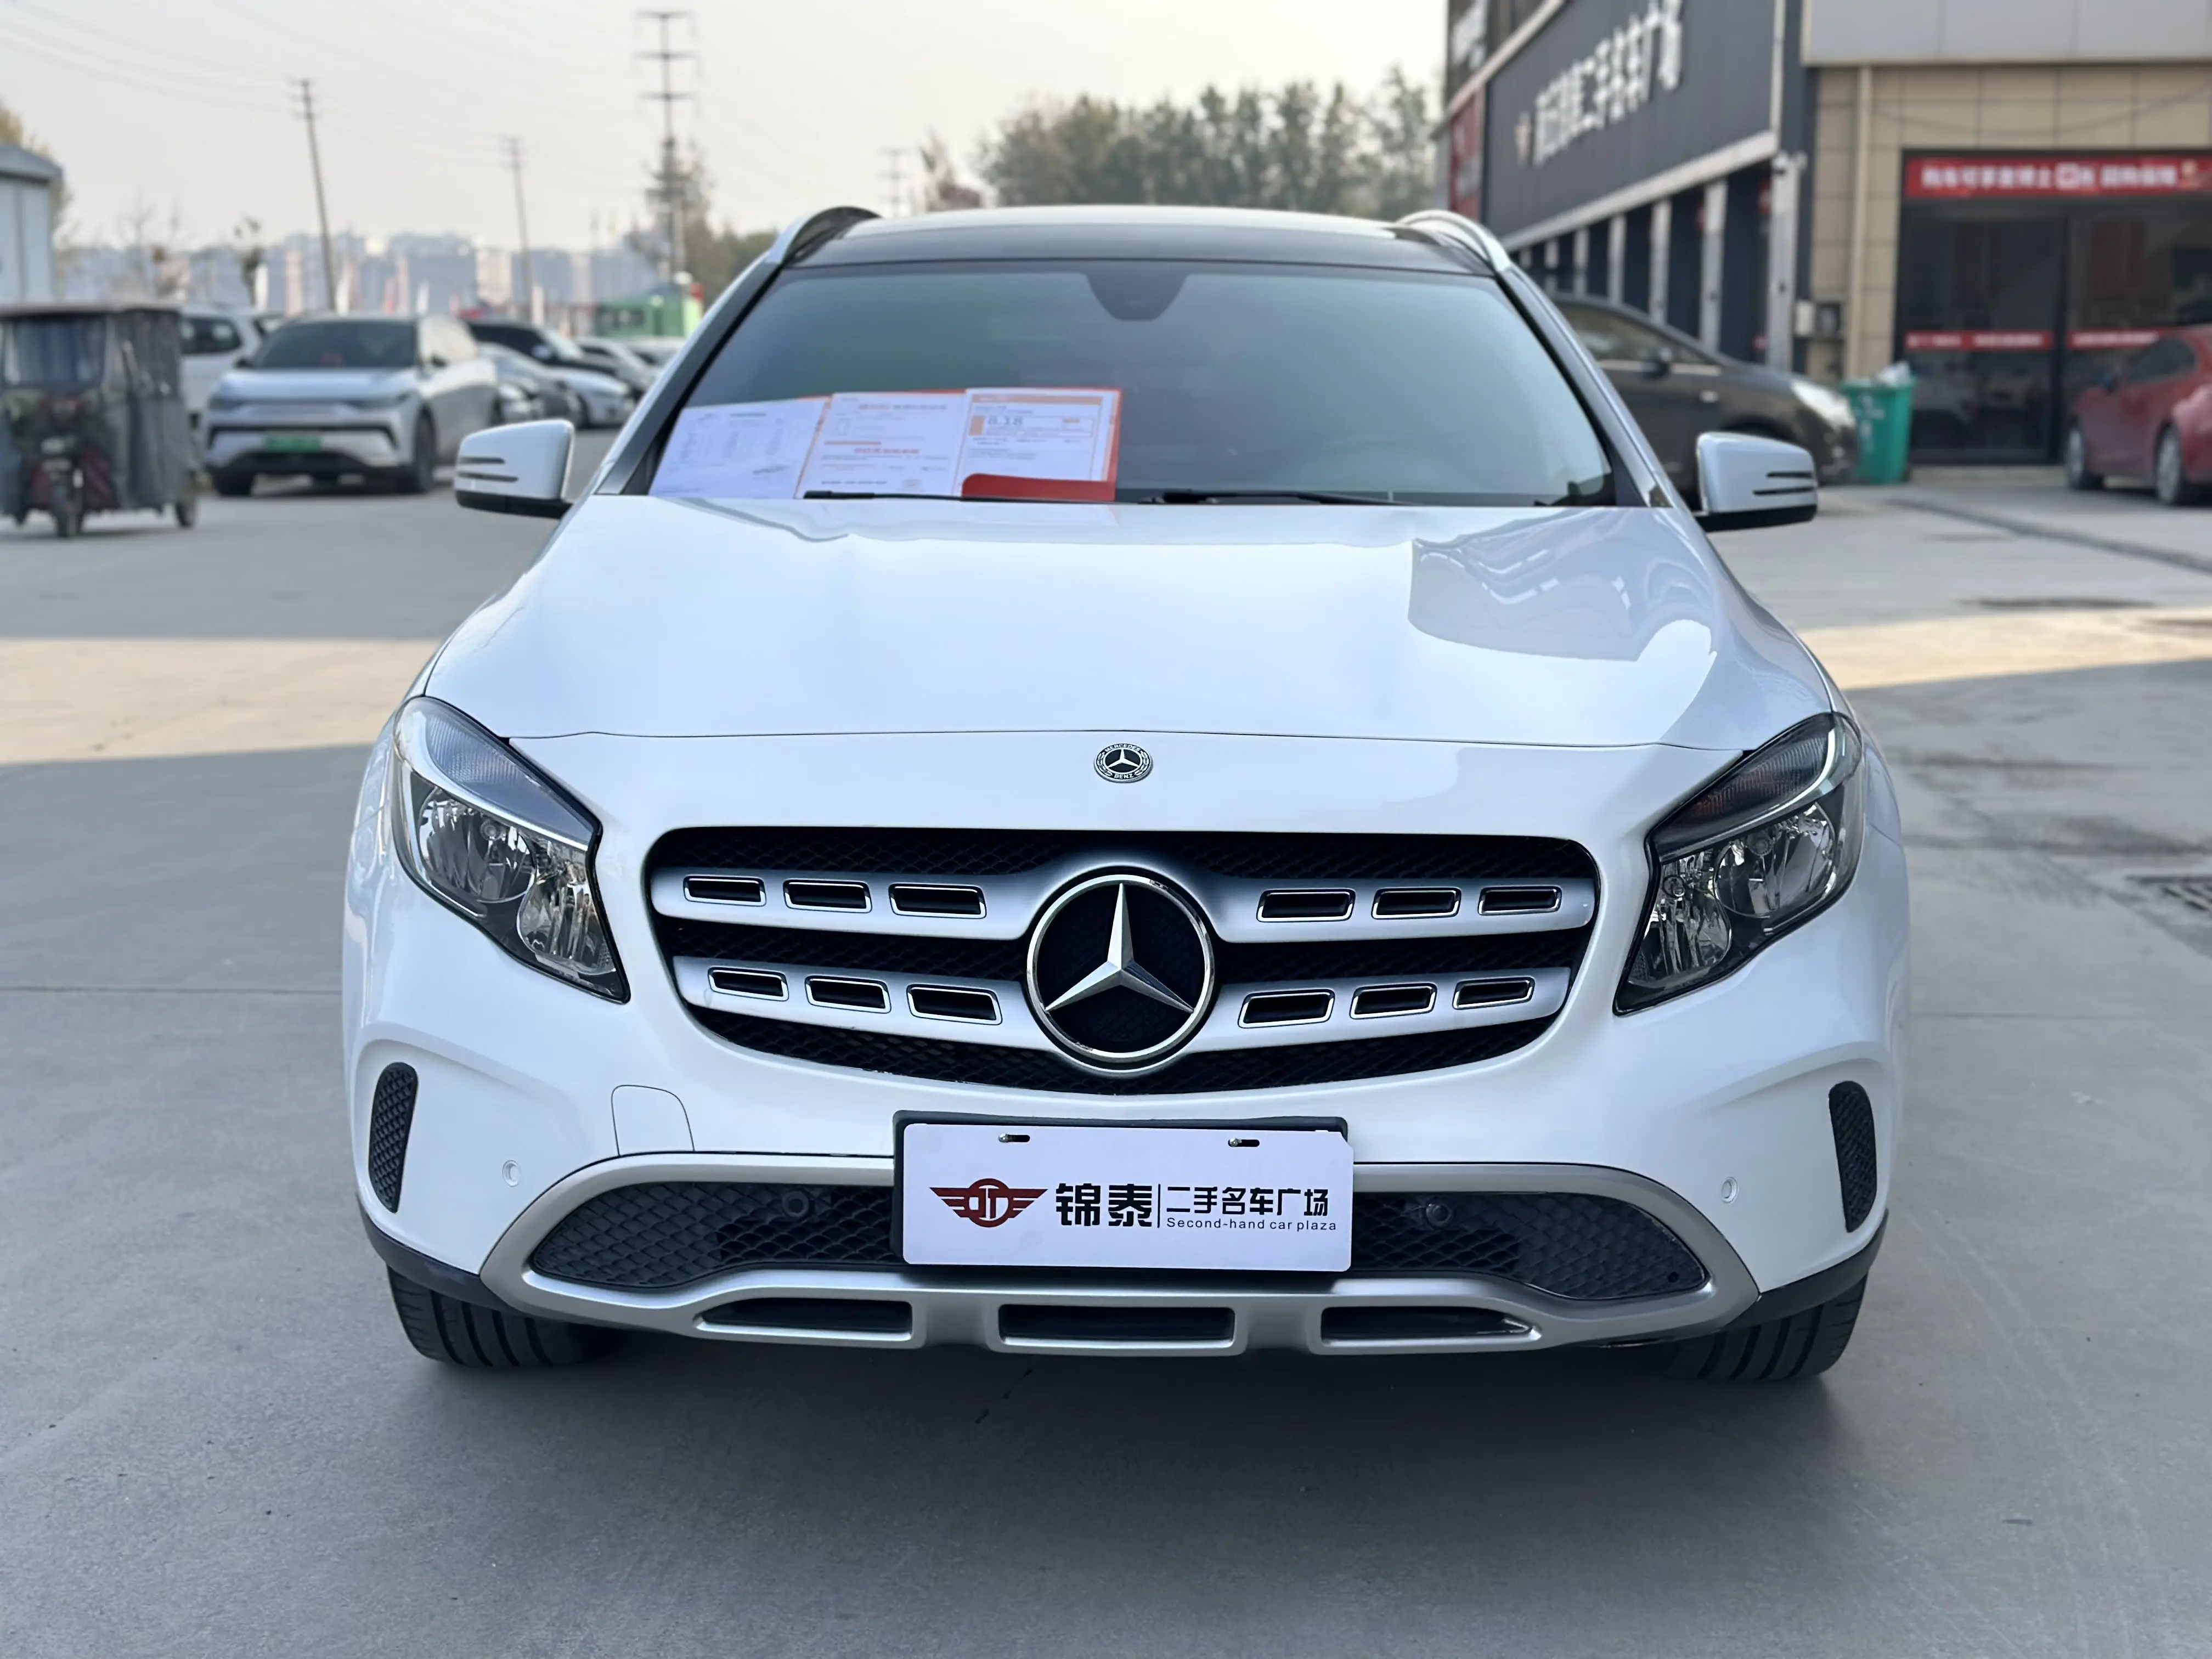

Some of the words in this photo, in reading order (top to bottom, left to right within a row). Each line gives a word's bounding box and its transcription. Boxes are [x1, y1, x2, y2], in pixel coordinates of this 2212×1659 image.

[1056, 1183, 1153, 1227] 锦泰
[1166, 1186, 1328, 1216] 二手名车广场
[1297, 1220, 1336, 1232] plaza
